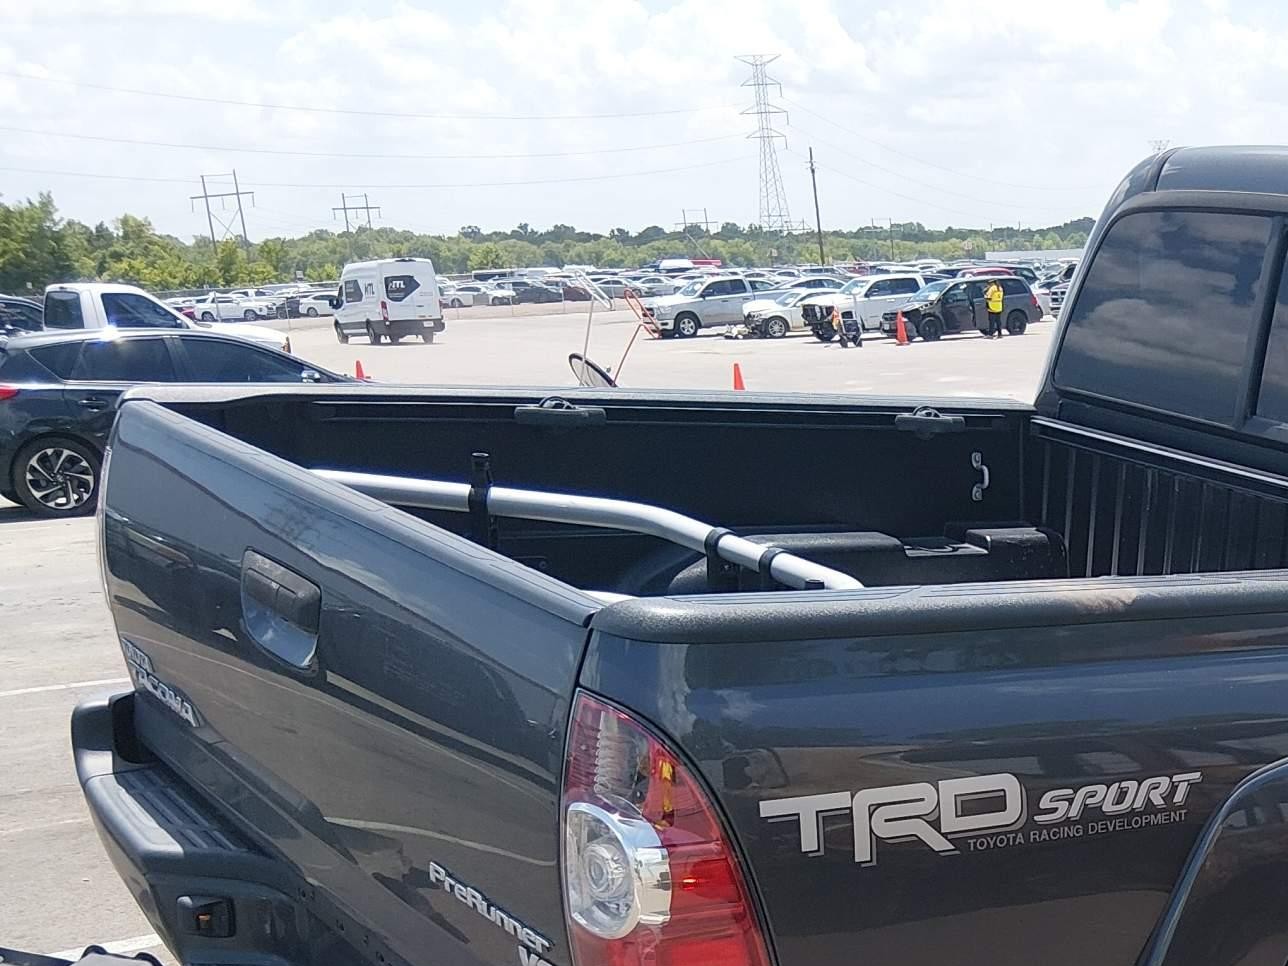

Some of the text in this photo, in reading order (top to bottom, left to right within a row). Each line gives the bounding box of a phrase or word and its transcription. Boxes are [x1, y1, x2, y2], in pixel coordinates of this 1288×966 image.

[128, 659, 201, 727] TACOMA
[759, 771, 1203, 867] TRD SPORT
[967, 809, 1188, 852] TOYOTA RACING DEVELOPMENT
[429, 861, 553, 954] PreRunner
